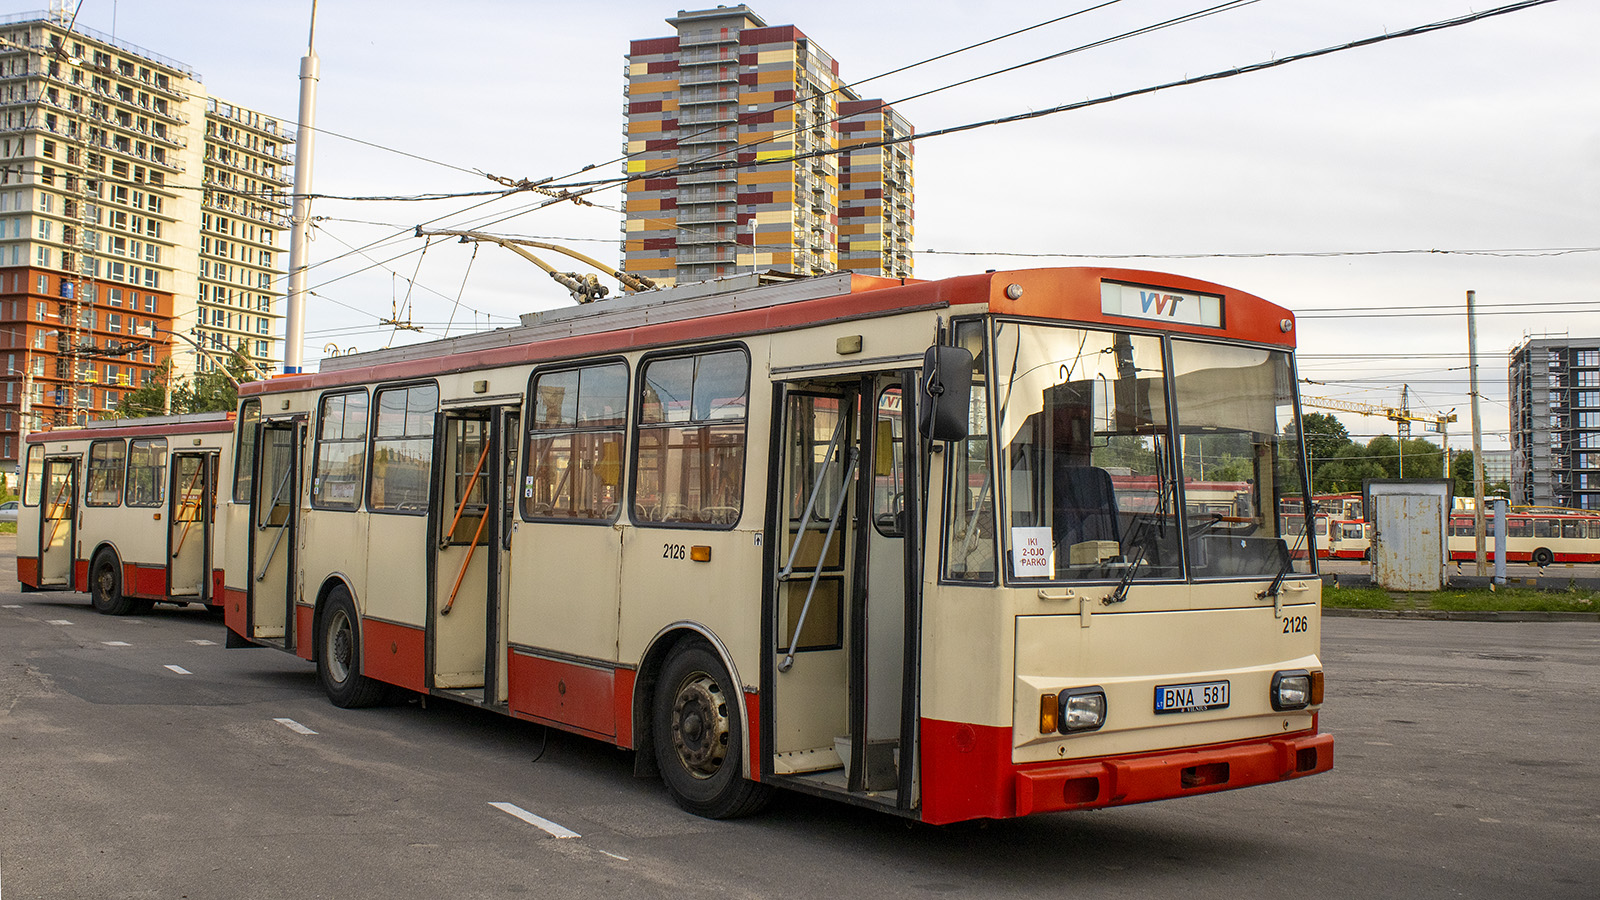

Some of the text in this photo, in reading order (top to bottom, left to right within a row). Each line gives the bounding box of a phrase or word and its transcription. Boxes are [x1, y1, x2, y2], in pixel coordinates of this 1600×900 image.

[1140, 291, 1184, 316] VVT
[1027, 537, 1038, 545] IKI
[663, 543, 686, 560] 2126
[1021, 558, 1046, 566] PARKO
[1282, 615, 1308, 634] 2126
[1165, 685, 1226, 708] BNA 581
